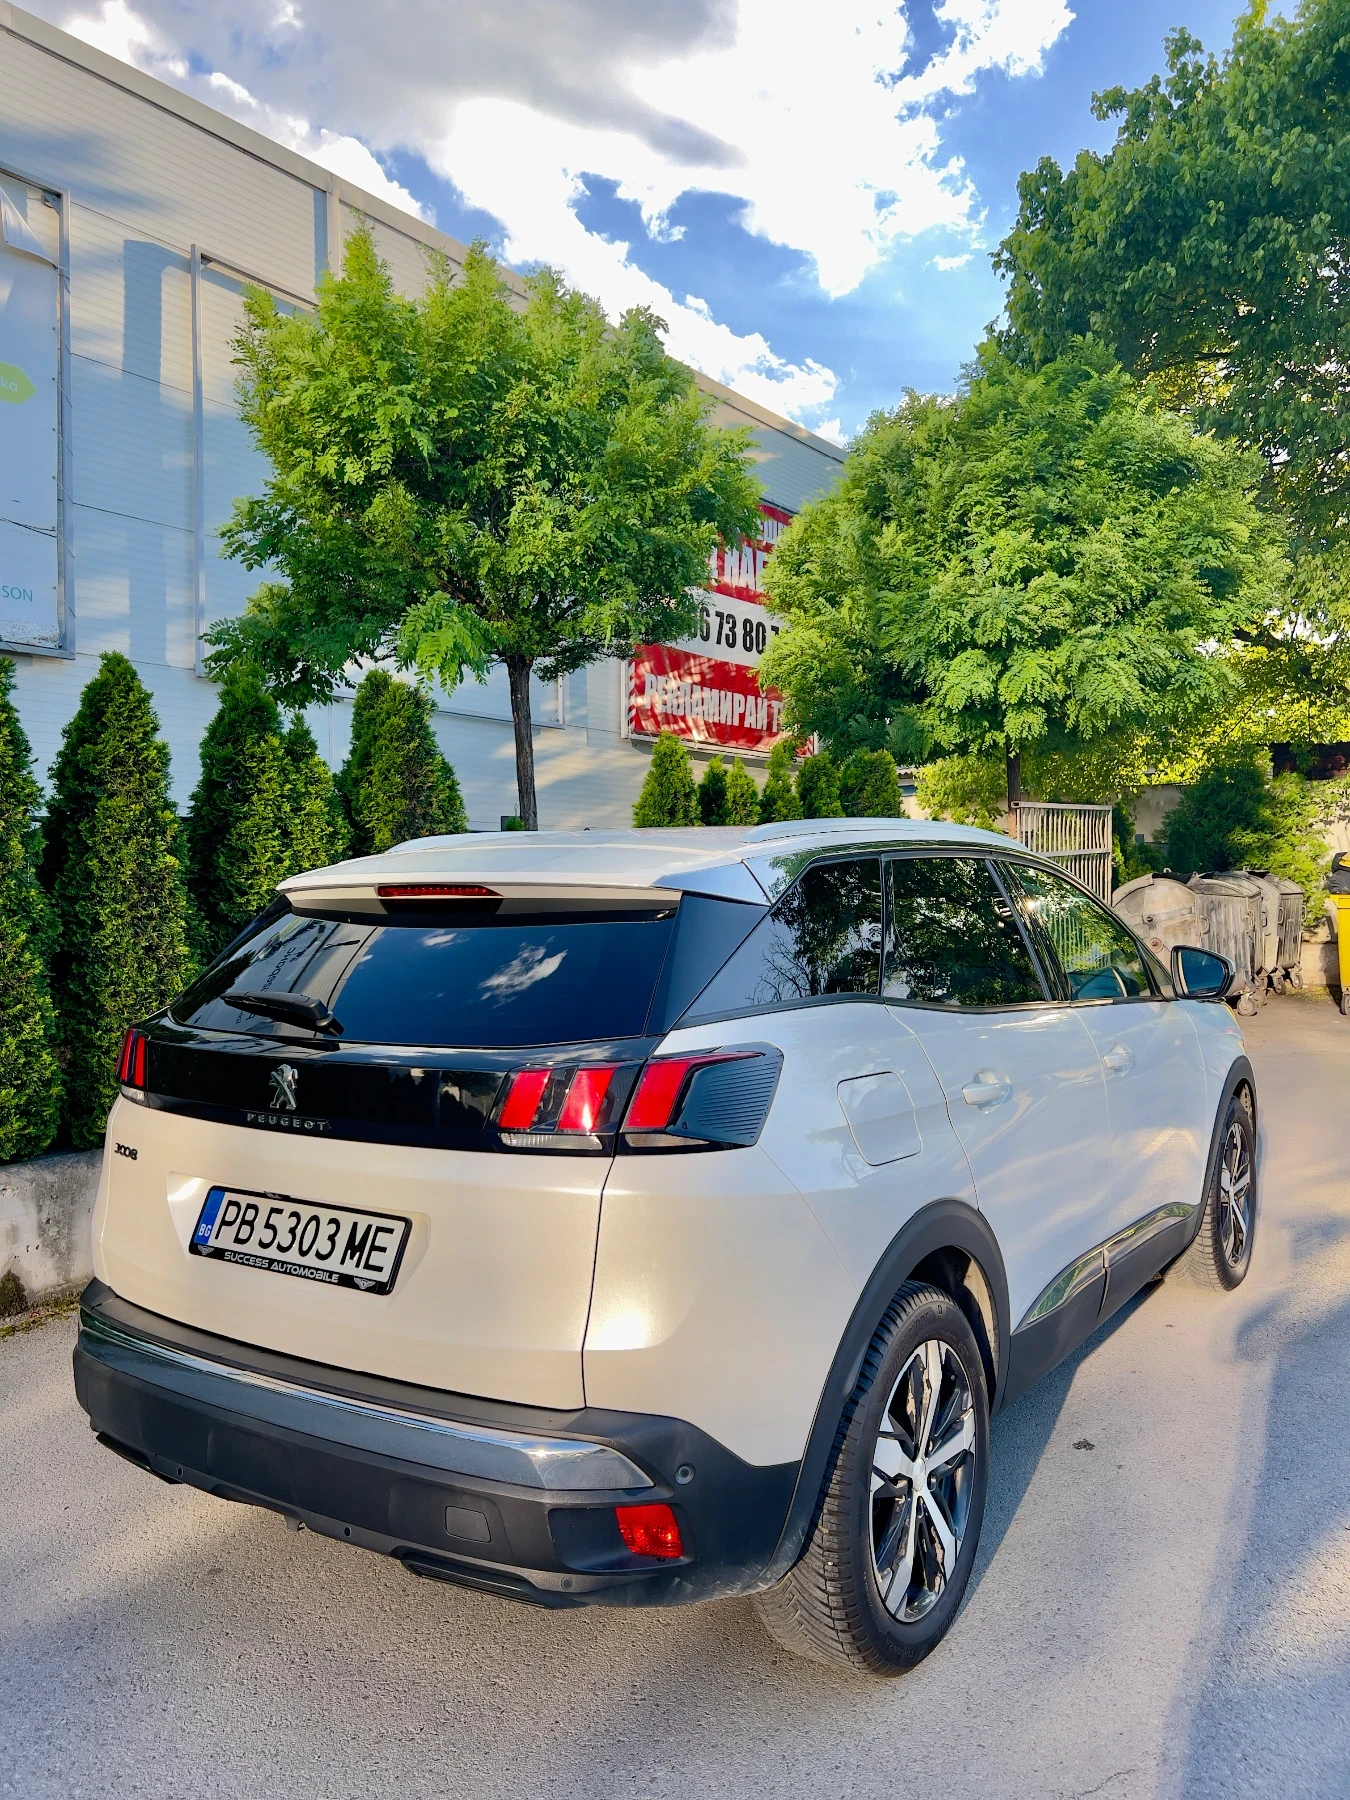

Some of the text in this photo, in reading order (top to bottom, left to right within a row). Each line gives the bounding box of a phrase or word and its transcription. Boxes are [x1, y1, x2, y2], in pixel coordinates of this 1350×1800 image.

[1, 585, 33, 602] SON
[715, 610, 737, 649] 73
[742, 617, 767, 655] 80
[643, 672, 769, 731] РЕКЛАМИРАЙ
[246, 1112, 329, 1131] PEUGEOT
[113, 1142, 139, 1161] 3008
[198, 1223, 212, 1237] BG
[214, 1199, 395, 1273] PB 5303 ME
[223, 1251, 340, 1283] SUCCESS AUTOMOBILE
